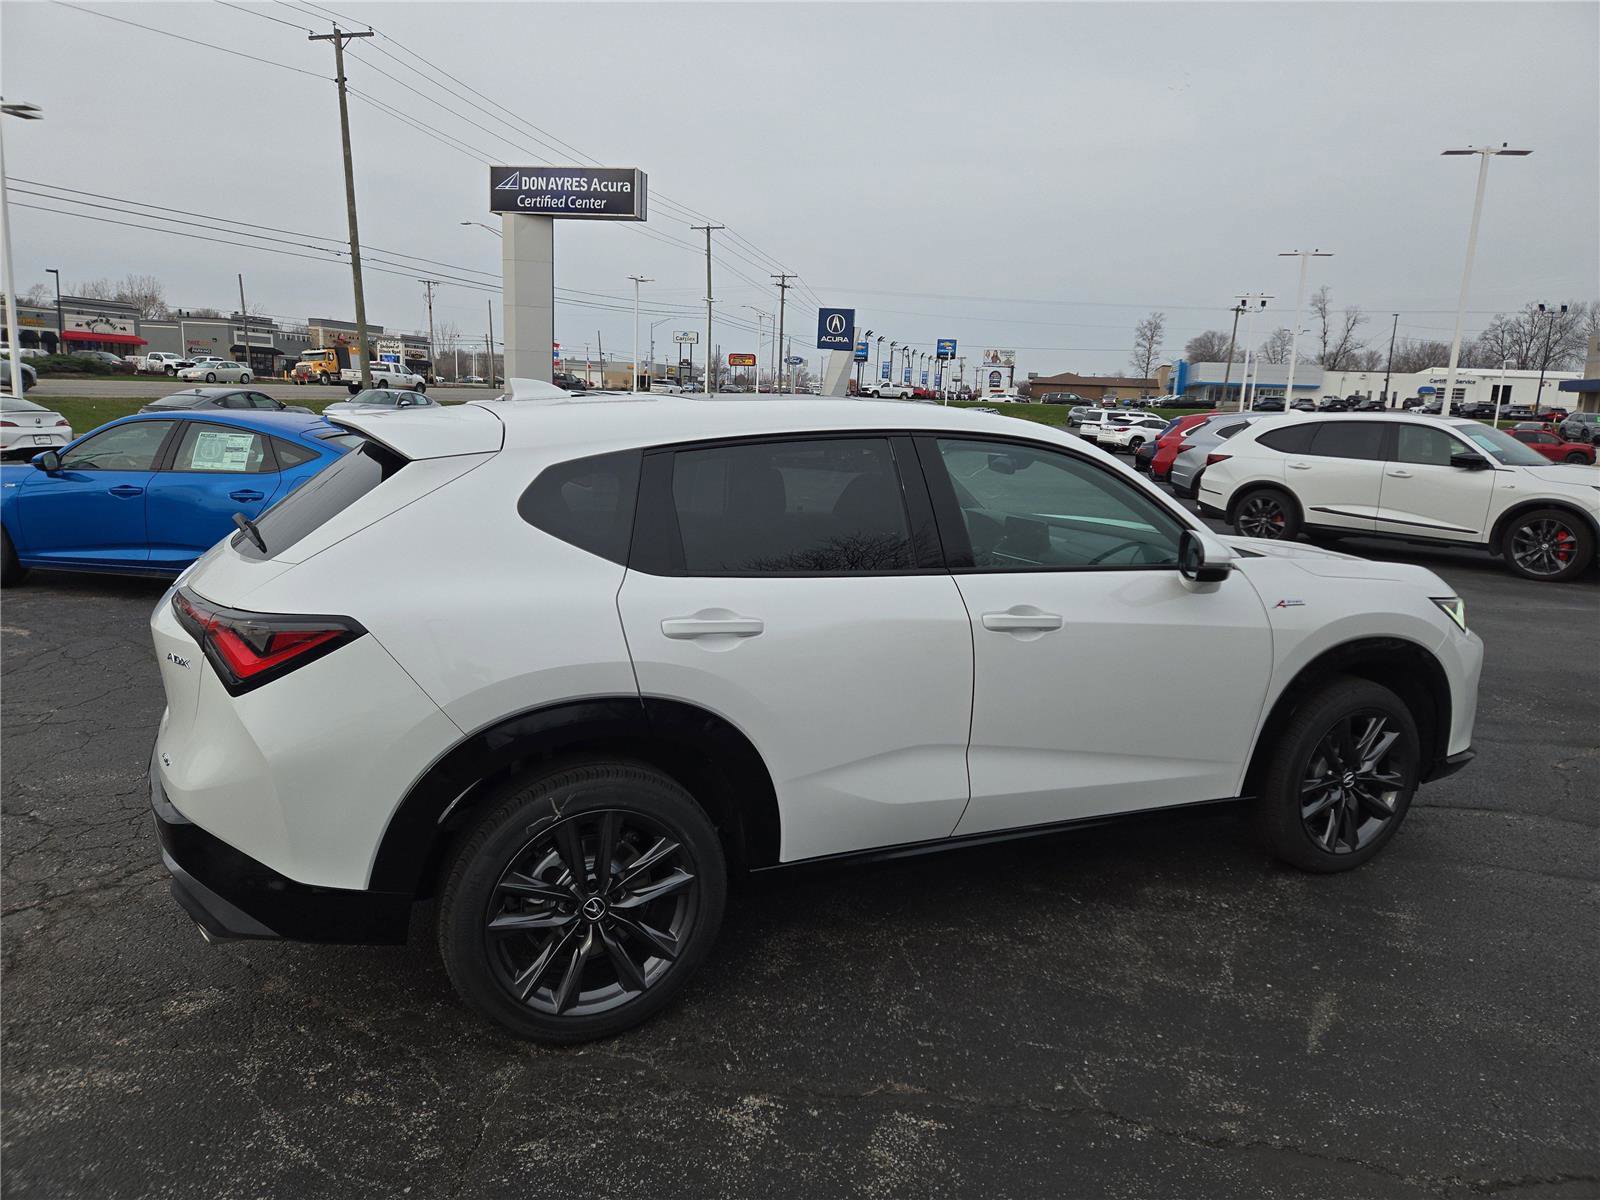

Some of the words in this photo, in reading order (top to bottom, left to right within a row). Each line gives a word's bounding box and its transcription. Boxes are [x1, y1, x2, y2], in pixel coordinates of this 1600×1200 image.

[521, 176, 546, 191] DON
[548, 177, 588, 191] AYRES
[590, 178, 631, 193] Acura
[517, 194, 565, 208] Certified
[567, 195, 607, 209] Center
[820, 335, 849, 343] ACURA
[167, 652, 191, 670] ADX
